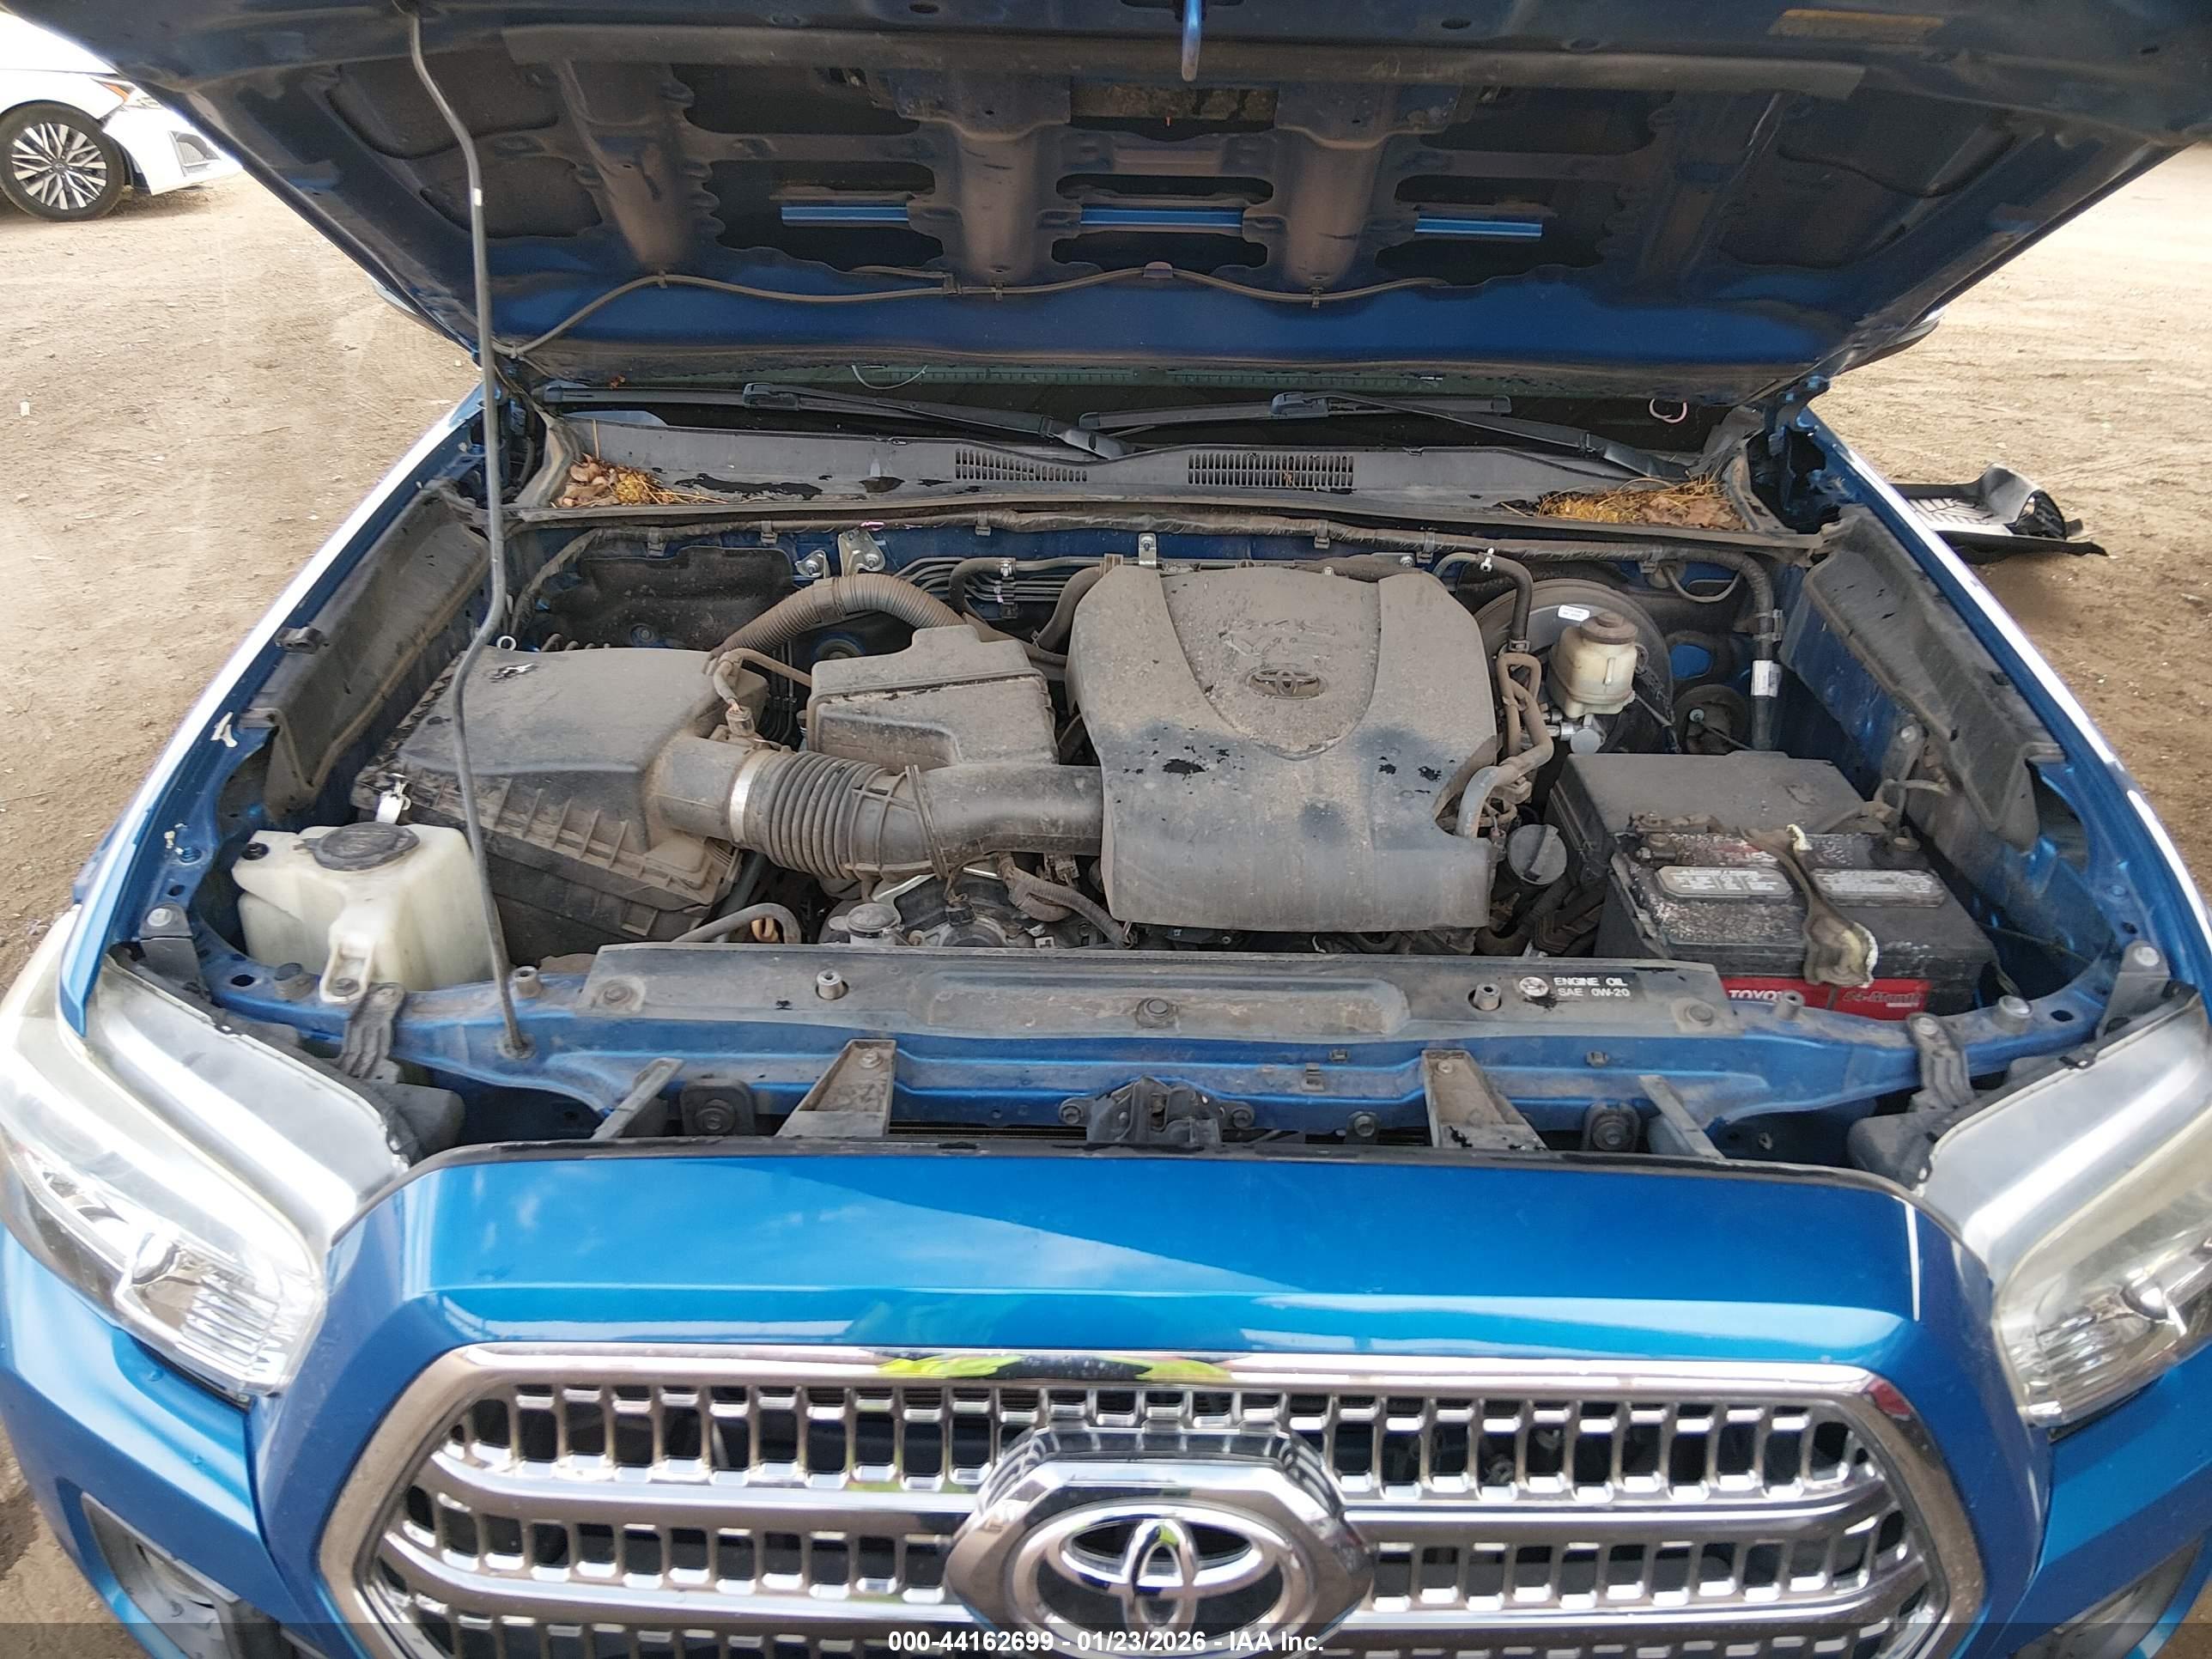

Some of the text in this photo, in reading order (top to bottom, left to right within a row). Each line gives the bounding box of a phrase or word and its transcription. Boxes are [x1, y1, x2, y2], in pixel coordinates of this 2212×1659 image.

[1553, 977, 1628, 987] ENGINE OIL
[1557, 988, 1631, 997] SAE 0W-20
[1728, 989, 1783, 1001] TOYO
